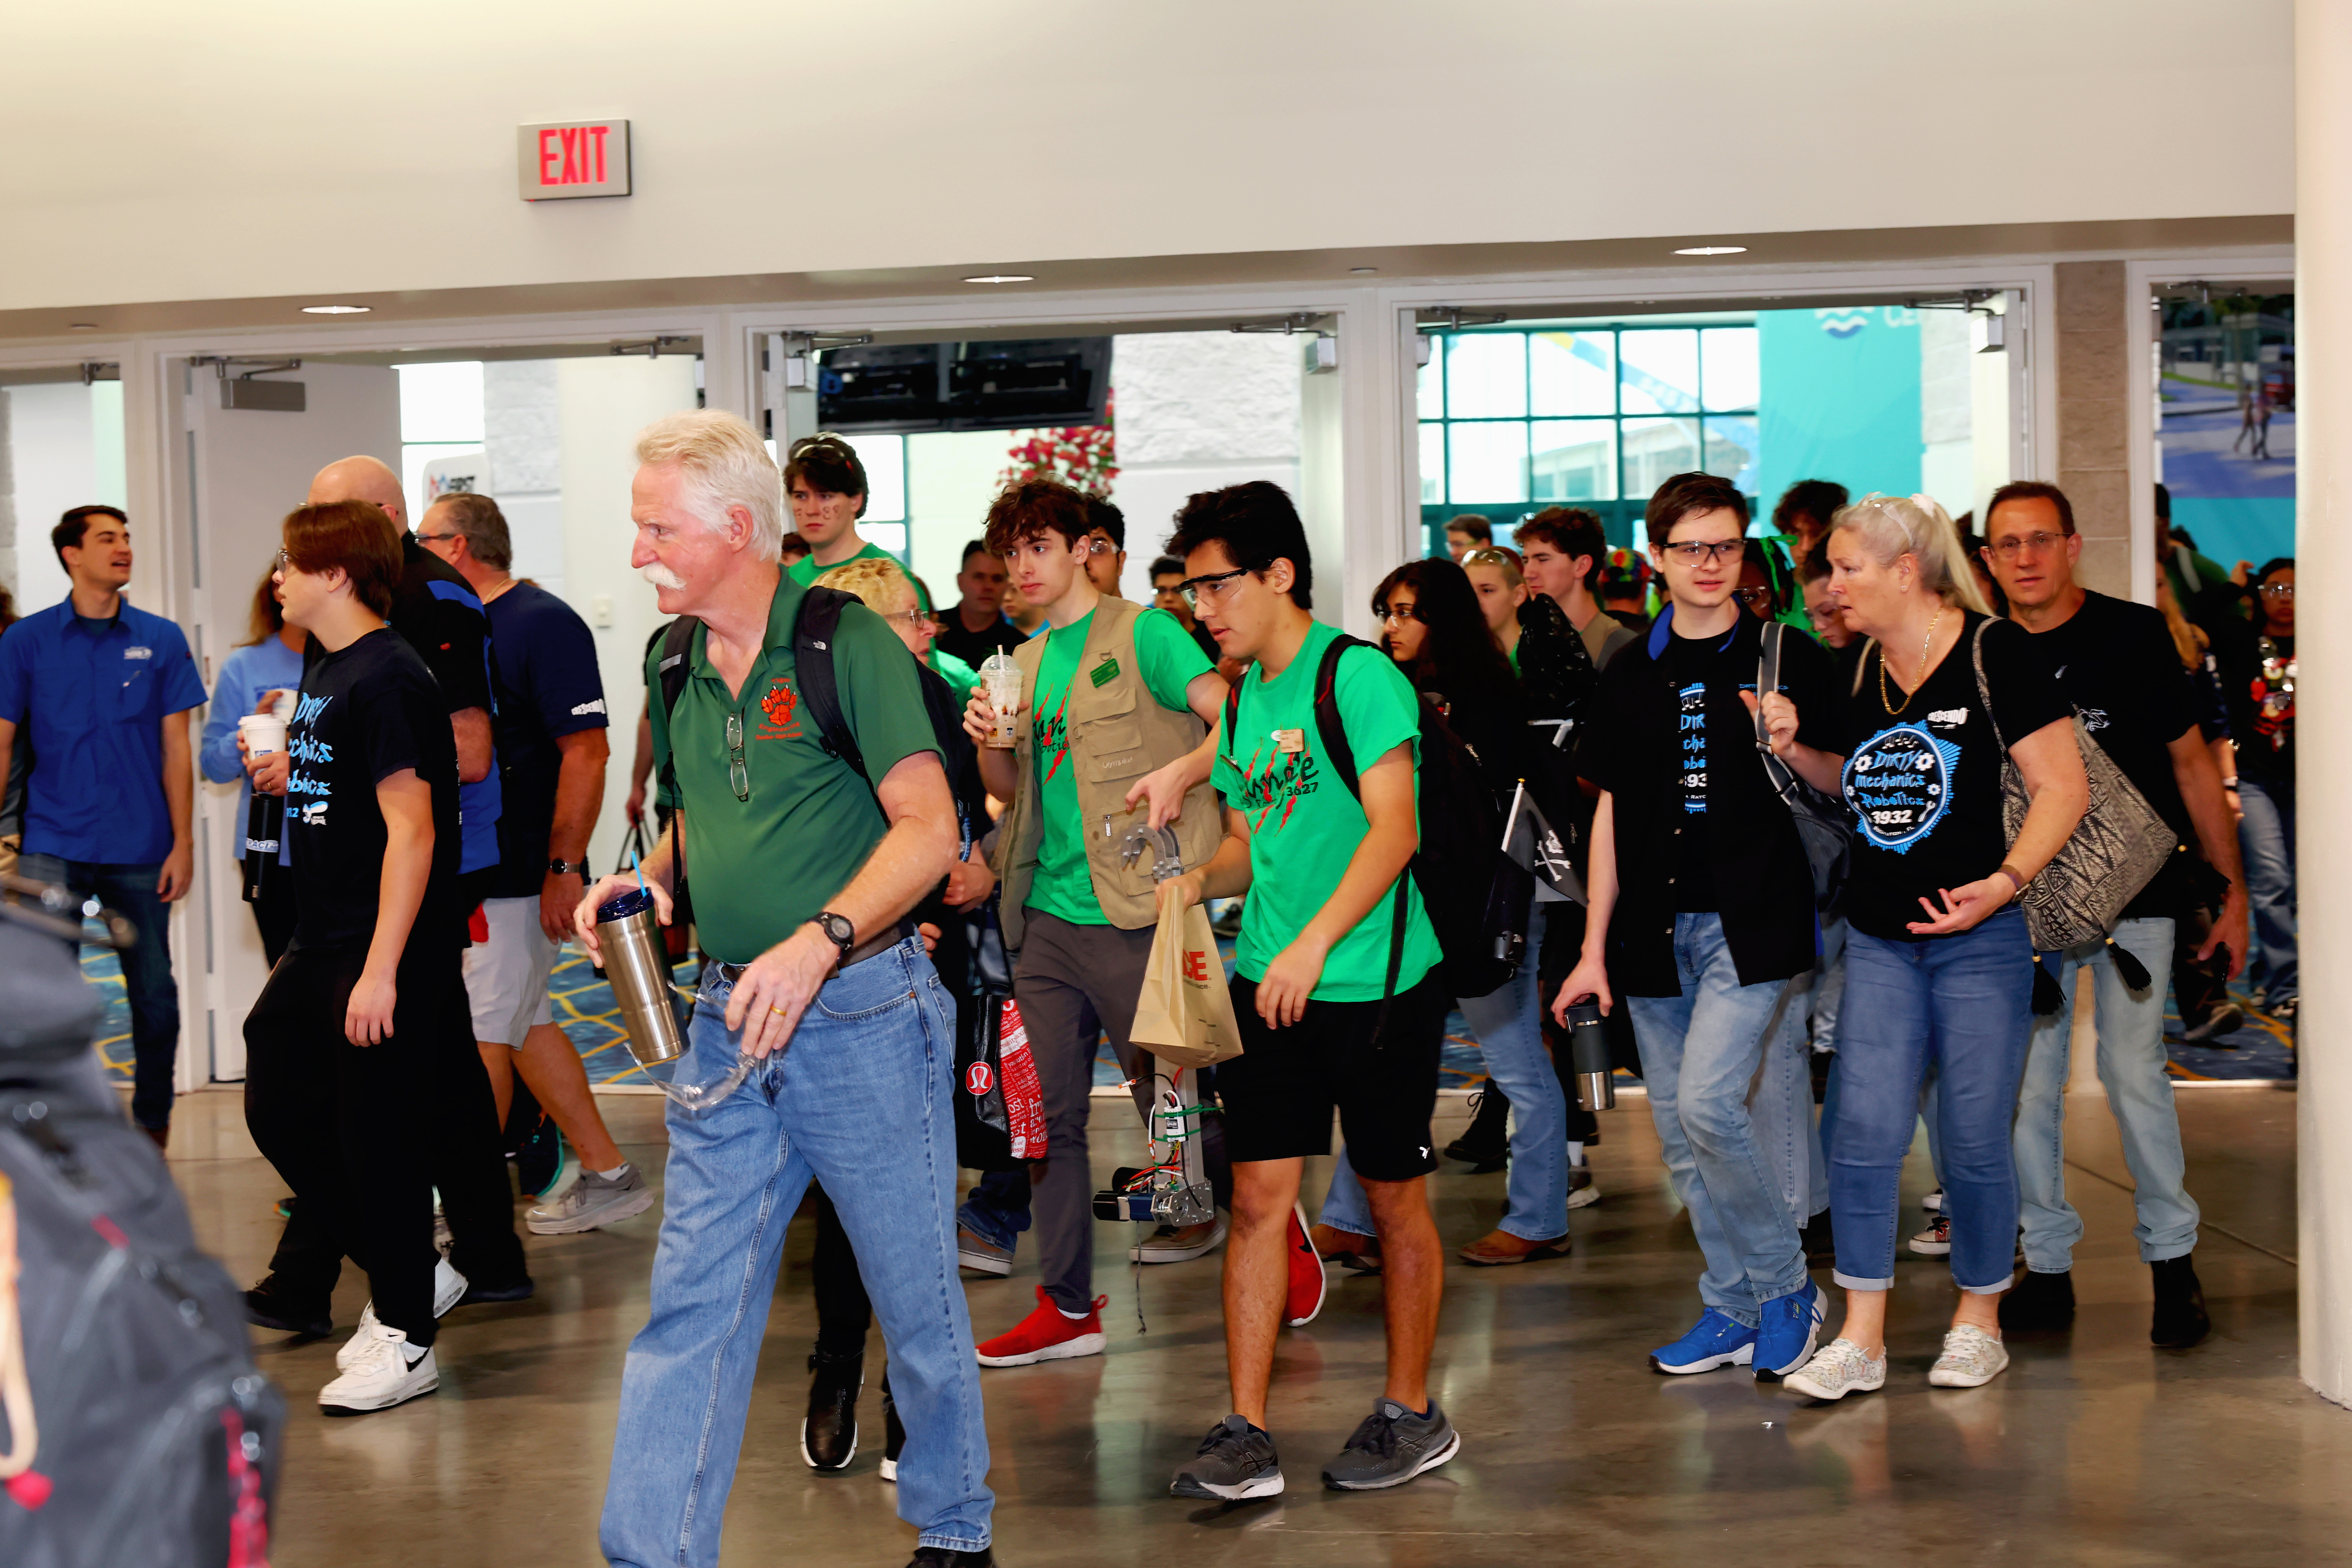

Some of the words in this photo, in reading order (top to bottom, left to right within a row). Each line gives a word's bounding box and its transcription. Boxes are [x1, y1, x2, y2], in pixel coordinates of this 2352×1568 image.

[539, 126, 611, 187] EXIT
[1927, 707, 1968, 725] CRESCENDO
[1870, 749, 1924, 771] DIRTY
[1286, 782, 1319, 797] 3627
[1870, 809, 1913, 825] 3932
